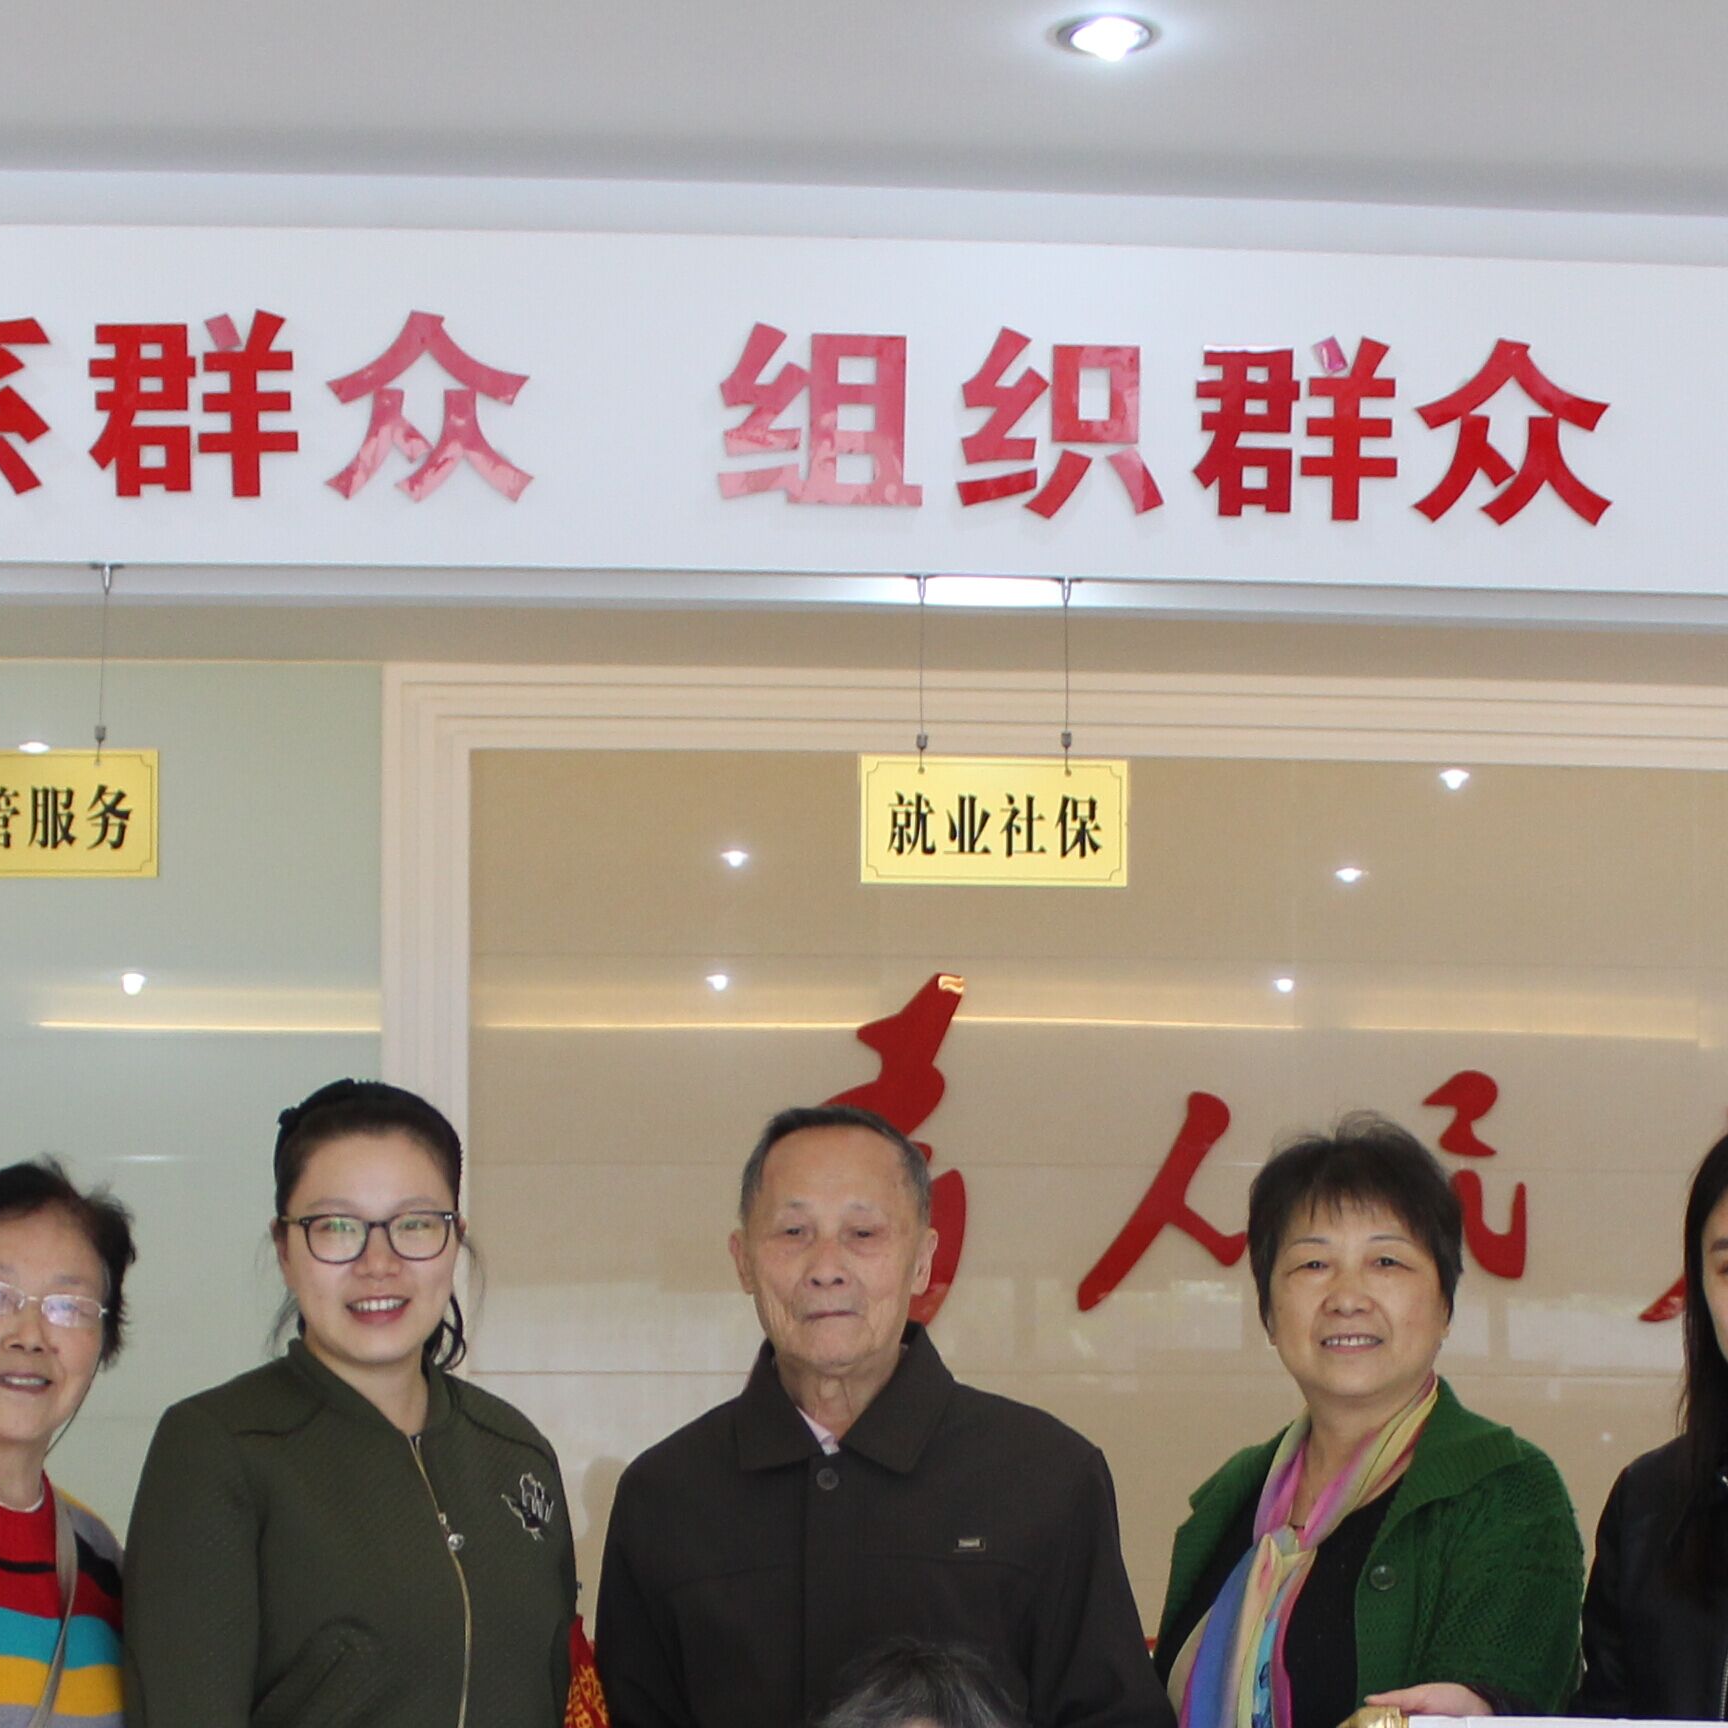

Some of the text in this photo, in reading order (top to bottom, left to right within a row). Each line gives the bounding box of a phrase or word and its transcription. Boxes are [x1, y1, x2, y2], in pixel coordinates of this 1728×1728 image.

[717, 322, 1612, 527] 组织群众
[887, 791, 1101, 858] 就业社保
